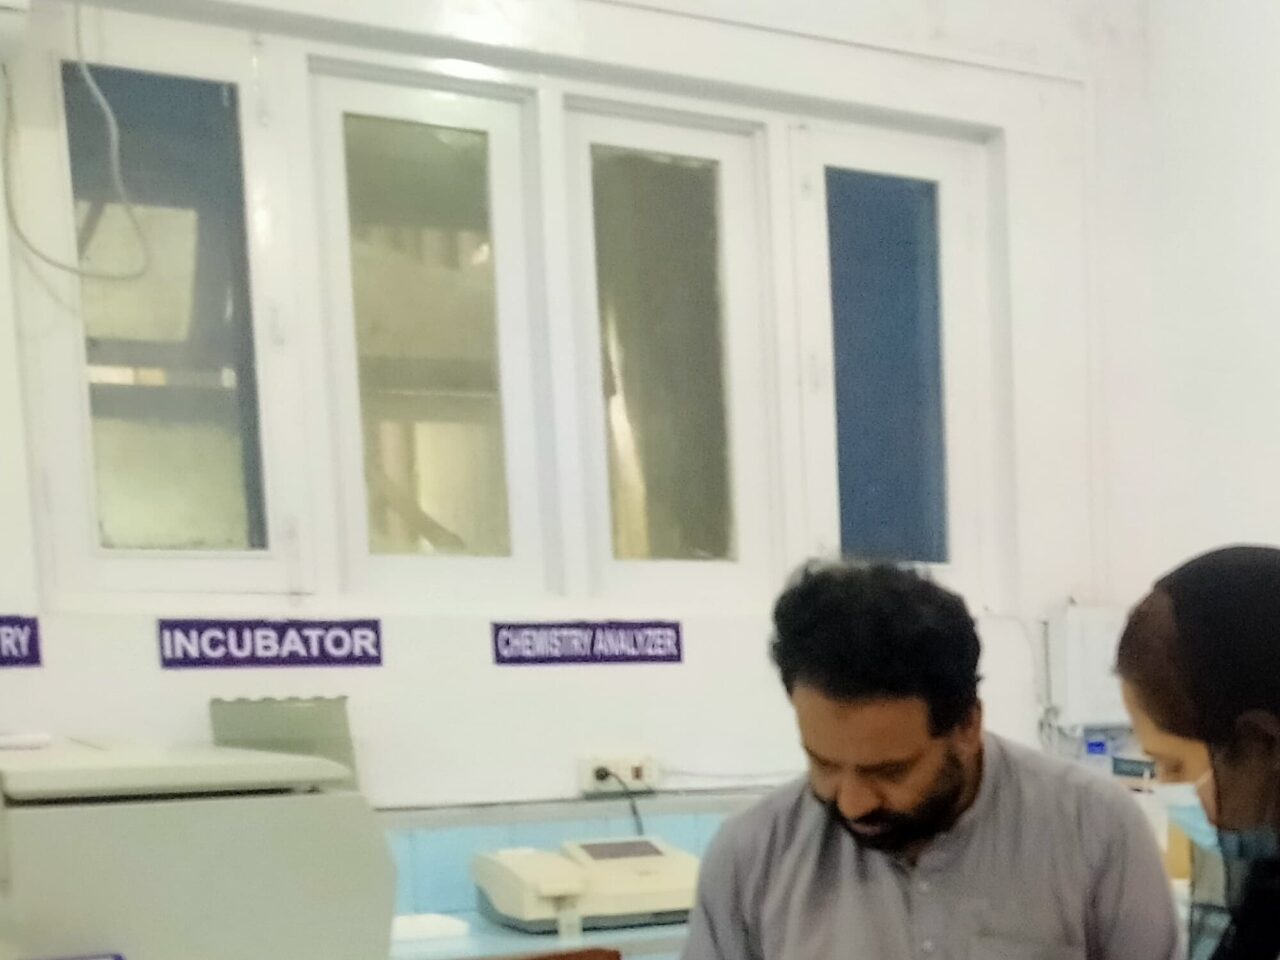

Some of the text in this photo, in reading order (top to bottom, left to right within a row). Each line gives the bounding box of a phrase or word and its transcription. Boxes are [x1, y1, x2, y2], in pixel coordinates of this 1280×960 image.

[161, 628, 377, 658] INCUBATOR
[499, 627, 678, 657] CHEMISTRY ANALYZER
